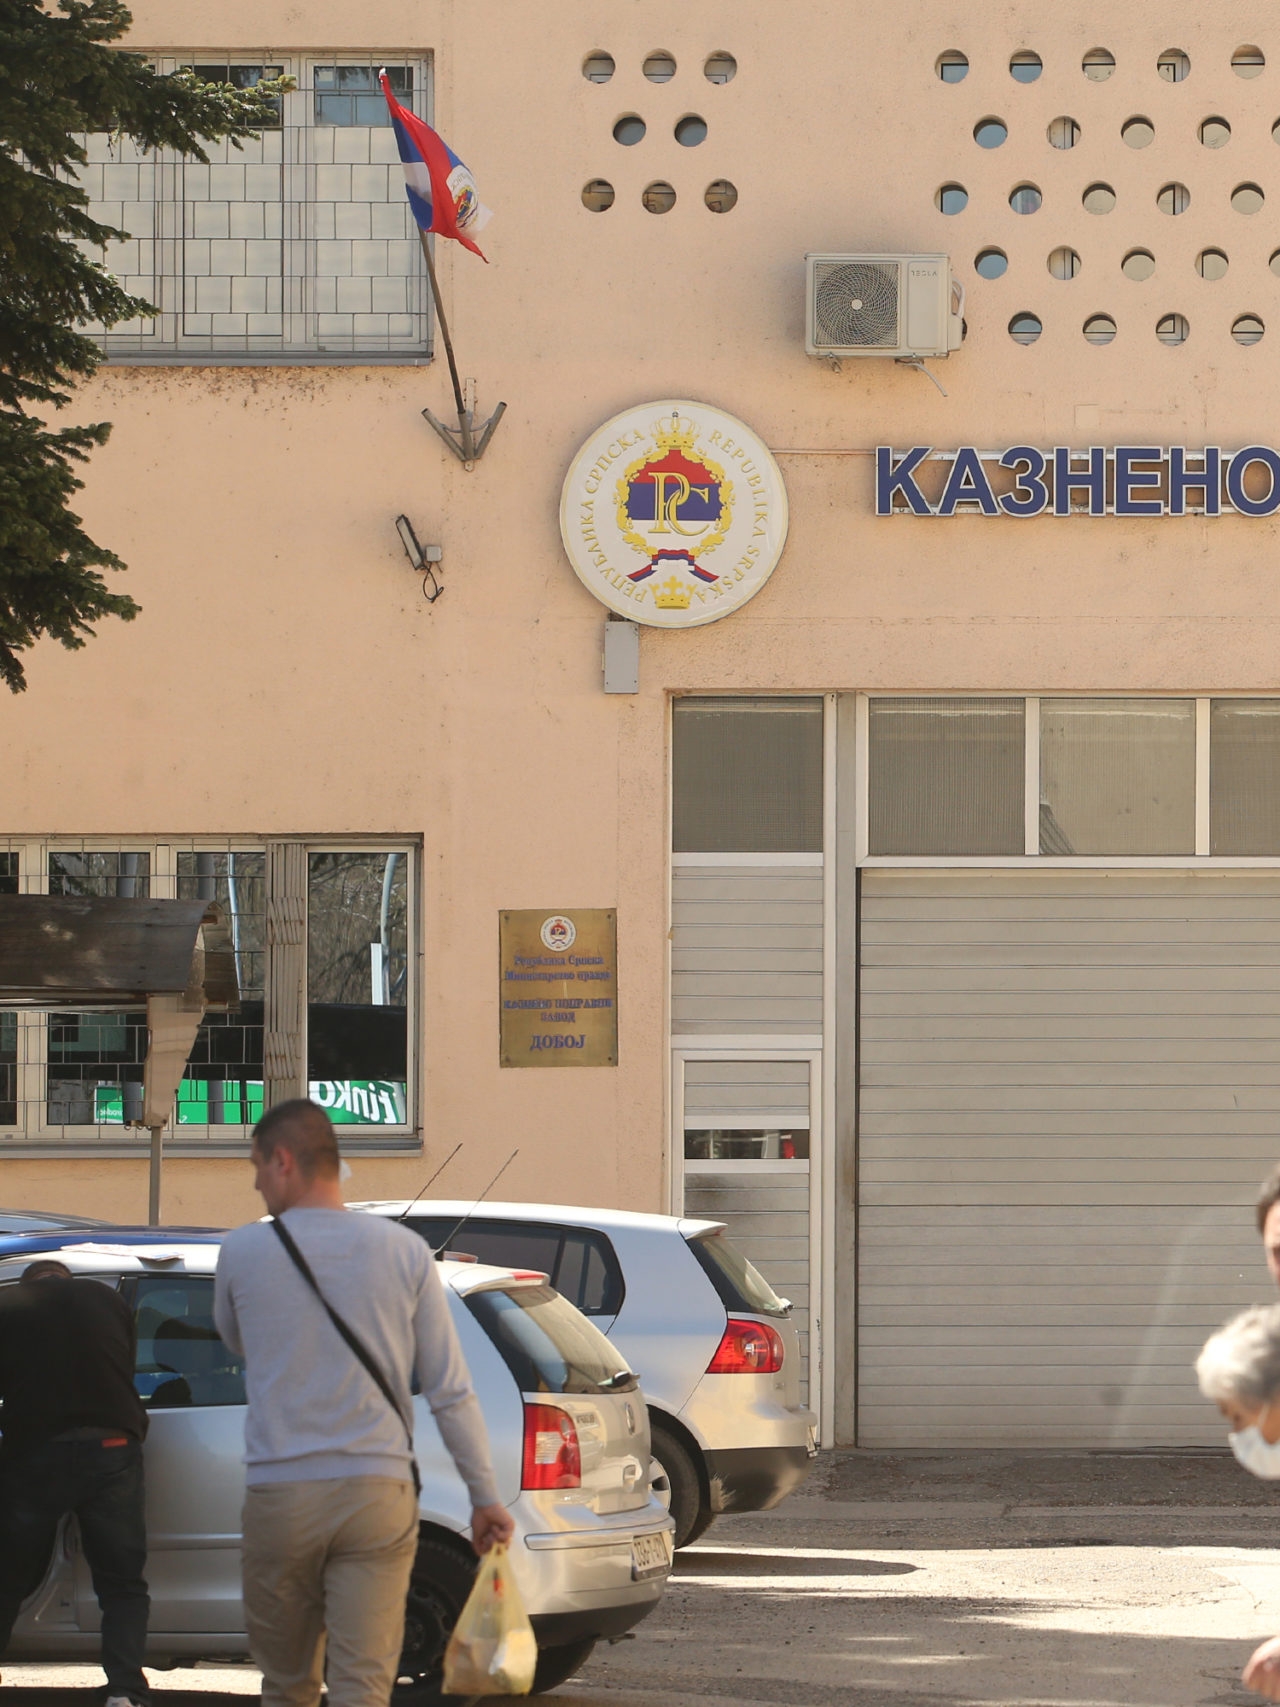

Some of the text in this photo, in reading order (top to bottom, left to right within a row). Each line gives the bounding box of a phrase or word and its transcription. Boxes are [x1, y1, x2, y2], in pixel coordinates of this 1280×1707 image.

[911, 269, 937, 278] TESLA
[579, 428, 648, 604] РЕПУБЛИКА СРПСКА
[694, 429, 769, 604] REPUBLIKA SRPSKA
[530, 1034, 586, 1051] ДОБОЈ
